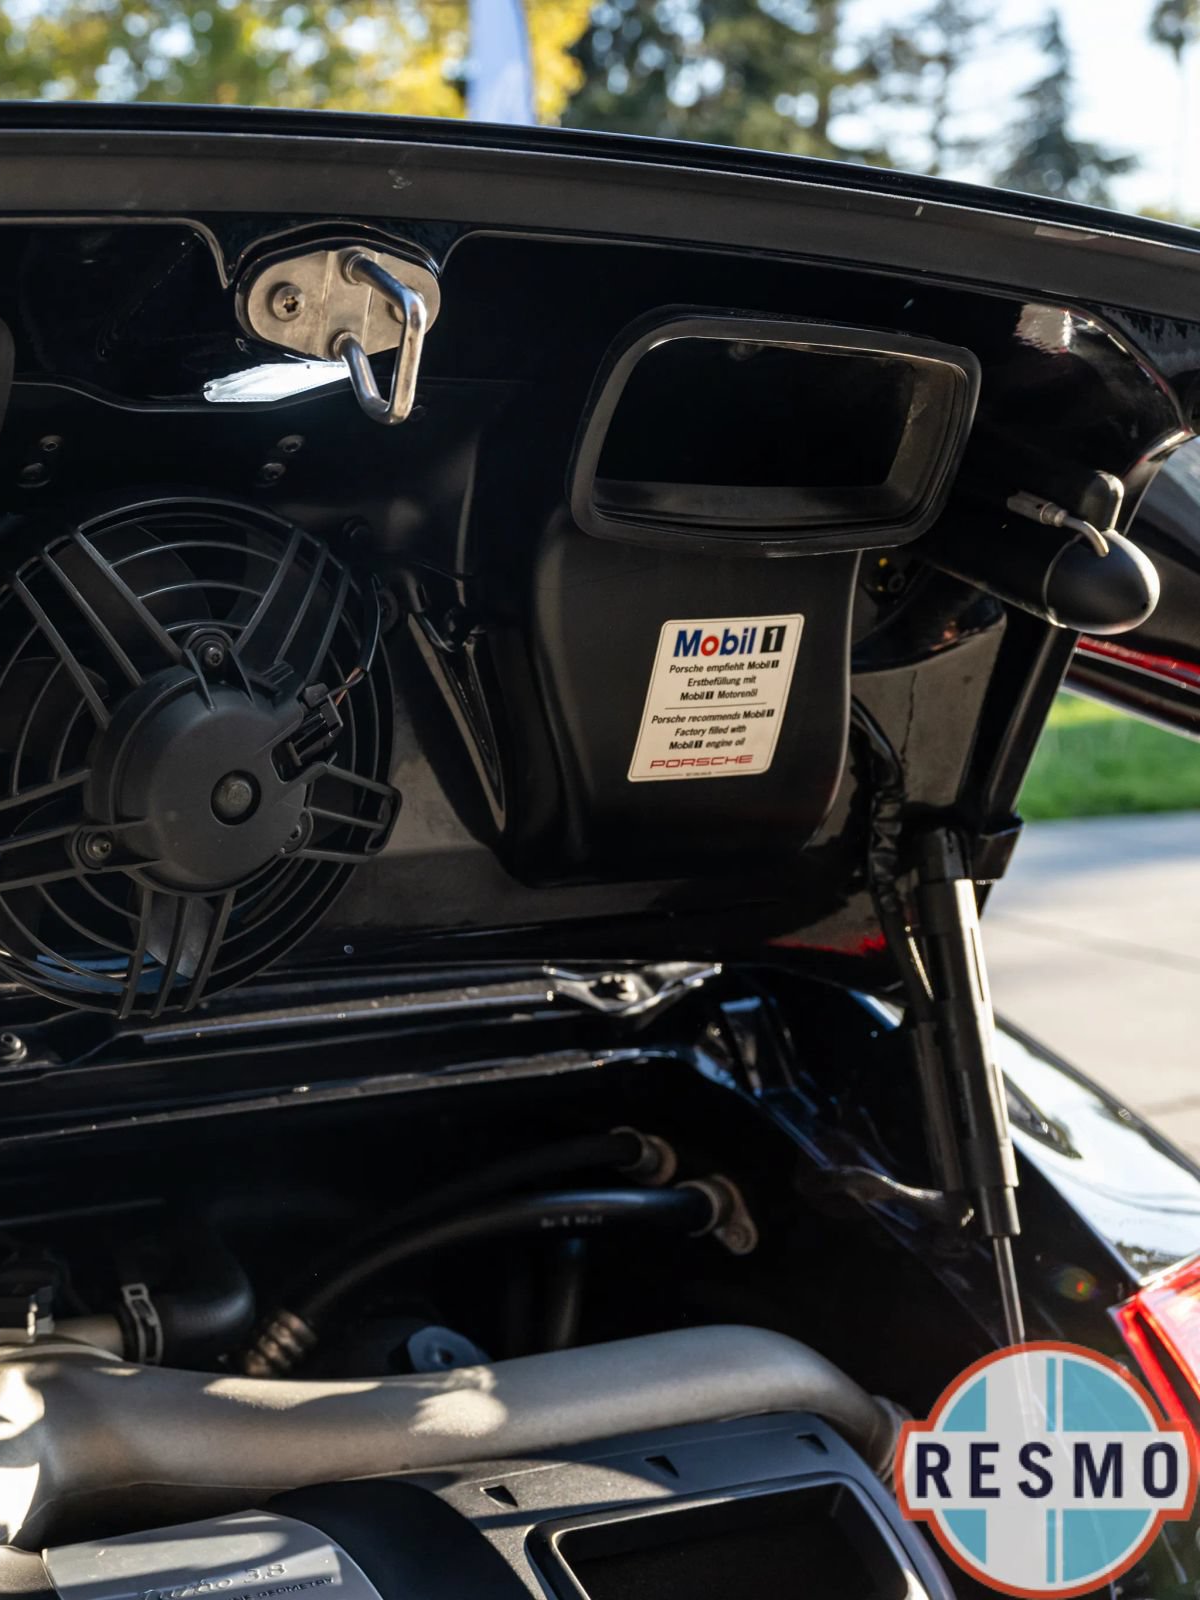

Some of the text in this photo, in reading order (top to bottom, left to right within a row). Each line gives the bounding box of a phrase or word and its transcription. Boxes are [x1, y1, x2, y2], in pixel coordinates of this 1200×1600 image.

[673, 627, 757, 657] Mobil
[669, 664, 704, 673] Porsche
[707, 663, 745, 673] empfiehlt
[688, 676, 756, 687] Erstbefüllung mit
[718, 689, 759, 699] Motorenöl
[652, 715, 686, 724] Porsche
[688, 712, 741, 723] recommends
[675, 725, 747, 737] Factory filled with
[706, 741, 733, 750] engine
[736, 738, 746, 746] oil
[650, 755, 754, 769] PORSCHE
[243, 1562, 288, 1584] 3.8
